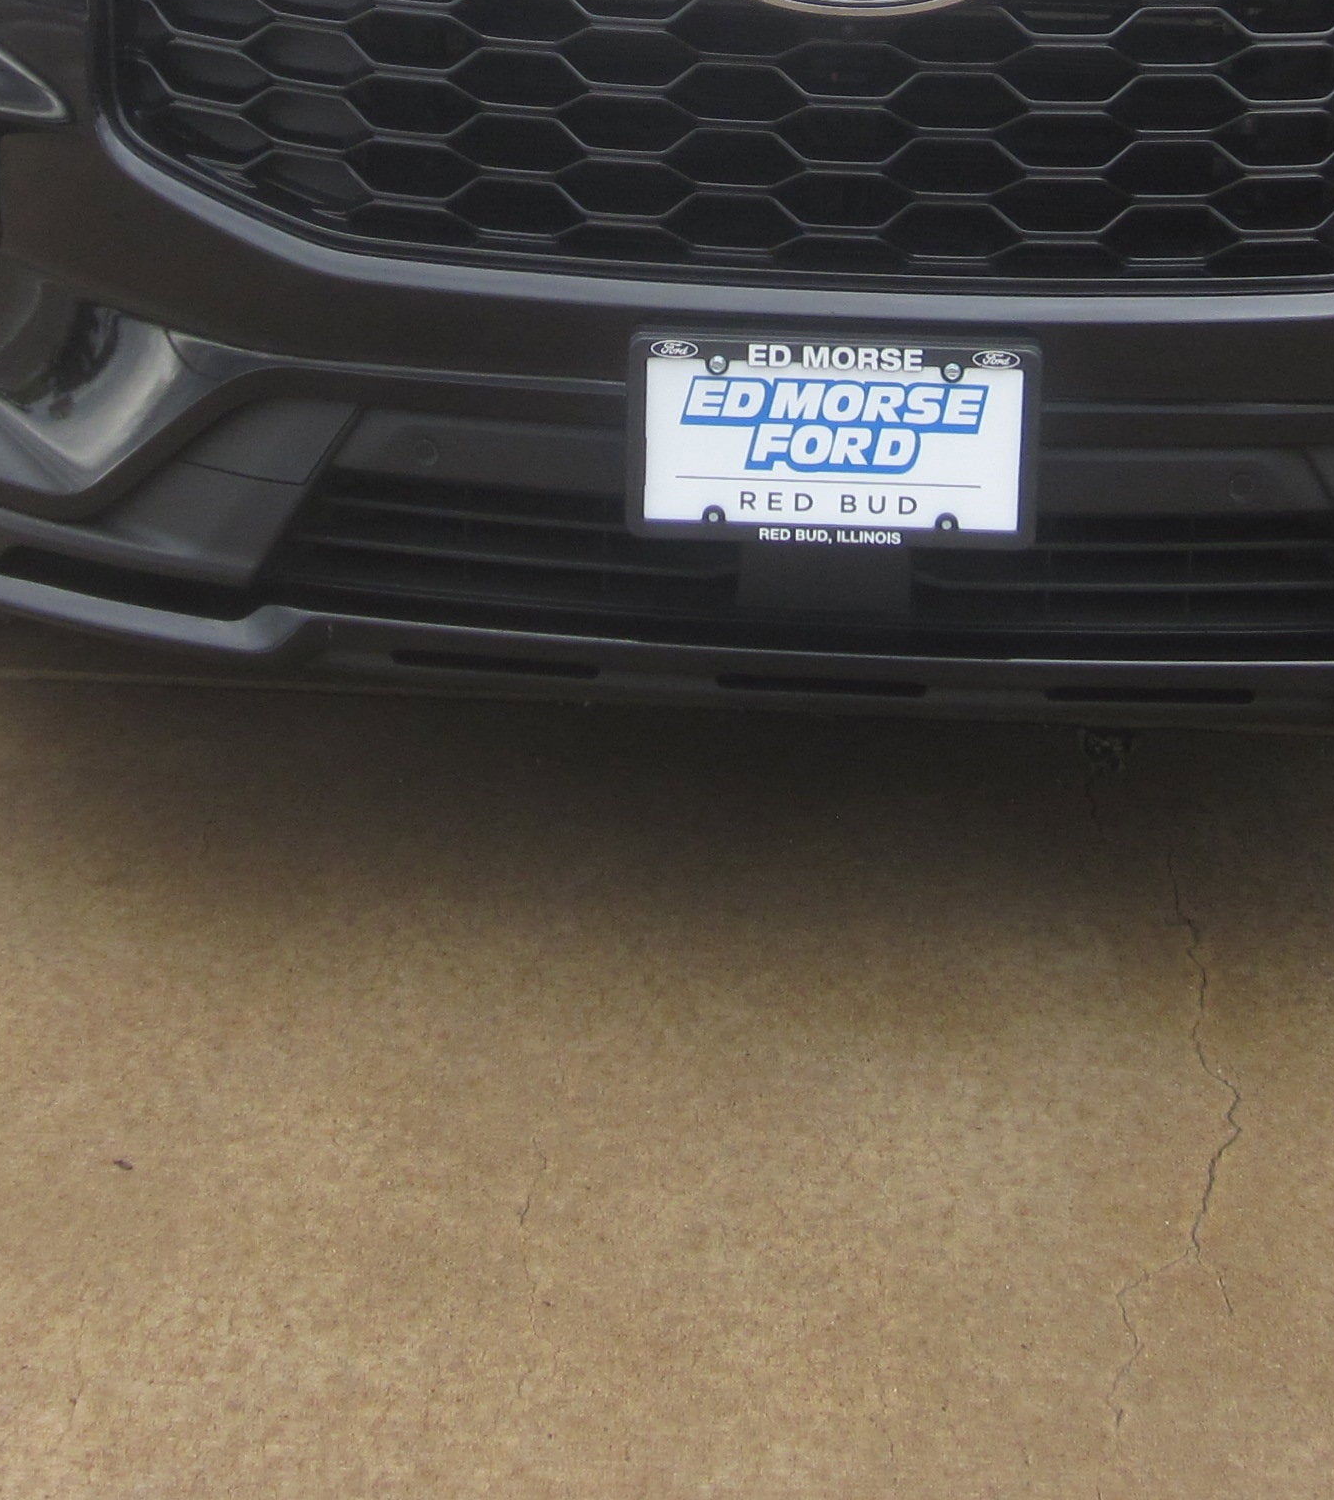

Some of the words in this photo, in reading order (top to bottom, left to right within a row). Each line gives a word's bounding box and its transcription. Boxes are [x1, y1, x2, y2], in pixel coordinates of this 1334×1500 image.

[660, 341, 690, 356] Ford
[748, 343, 792, 368] ED
[803, 346, 924, 373] MORSE
[982, 352, 1011, 367] Ford
[685, 378, 766, 419] ED
[768, 381, 984, 426] MORSE
[751, 422, 917, 467] FORD
[739, 490, 814, 512] RED
[840, 494, 918, 516] BUD
[758, 527, 791, 541] RED
[795, 529, 832, 545] BUD,
[836, 530, 902, 545] ILLINOIS
